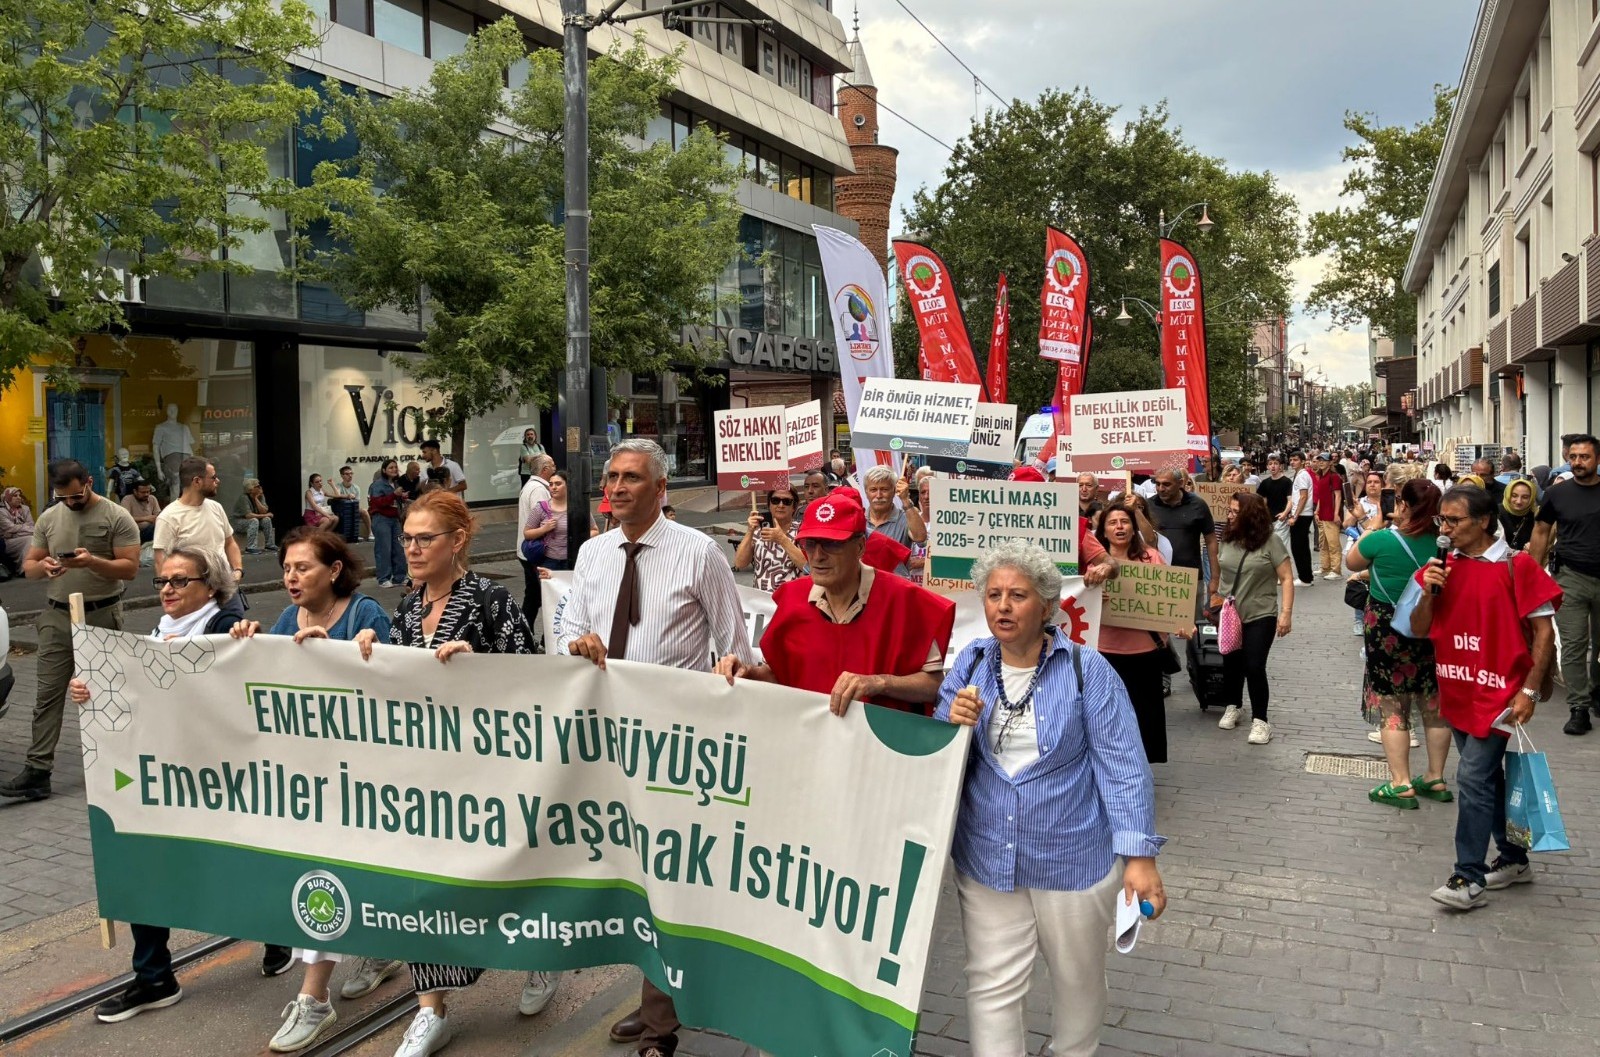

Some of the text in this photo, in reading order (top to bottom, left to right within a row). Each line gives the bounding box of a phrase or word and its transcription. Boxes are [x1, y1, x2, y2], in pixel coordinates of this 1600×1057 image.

[864, 388, 973, 410] BİR ÖMÜR HİZMET,
[1074, 396, 1182, 416] EMEKLİLİK DEĞİL,
[719, 414, 781, 438] SÖZ HAKKI
[786, 413, 820, 433] FAİZDE
[860, 406, 969, 426] KARŞILIĞI İHANET.
[975, 414, 1013, 431] DİRİ DİRİ
[1093, 414, 1164, 430] BU RESMEN
[970, 429, 1001, 447] ÜNÜZ
[1101, 430, 1156, 445] SEFALET.
[722, 437, 782, 462] EMEKLİDE
[949, 486, 1057, 510] EMEKLİ MAAŞI
[936, 509, 1071, 531] 2002= 7 ÇEYREK ALTIN
[936, 531, 974, 548] 2025=
[977, 534, 985, 549] 2
[1165, 571, 1193, 585] DEĞİL
[1105, 579, 1190, 600] BU RESMEN
[1476, 669, 1507, 689] SEN
[253, 688, 747, 807] EMEKLİLERİN SESİ YÜRÜYÜŞÜ
[139, 754, 329, 823] Emekliler
[339, 761, 507, 848] İnsanca
[729, 820, 928, 987] İstiyor!
[306, 878, 336, 896] BURSA
[299, 902, 316, 928] KENT
[361, 902, 489, 936] Emekliler
[497, 912, 625, 947] Çalışma
